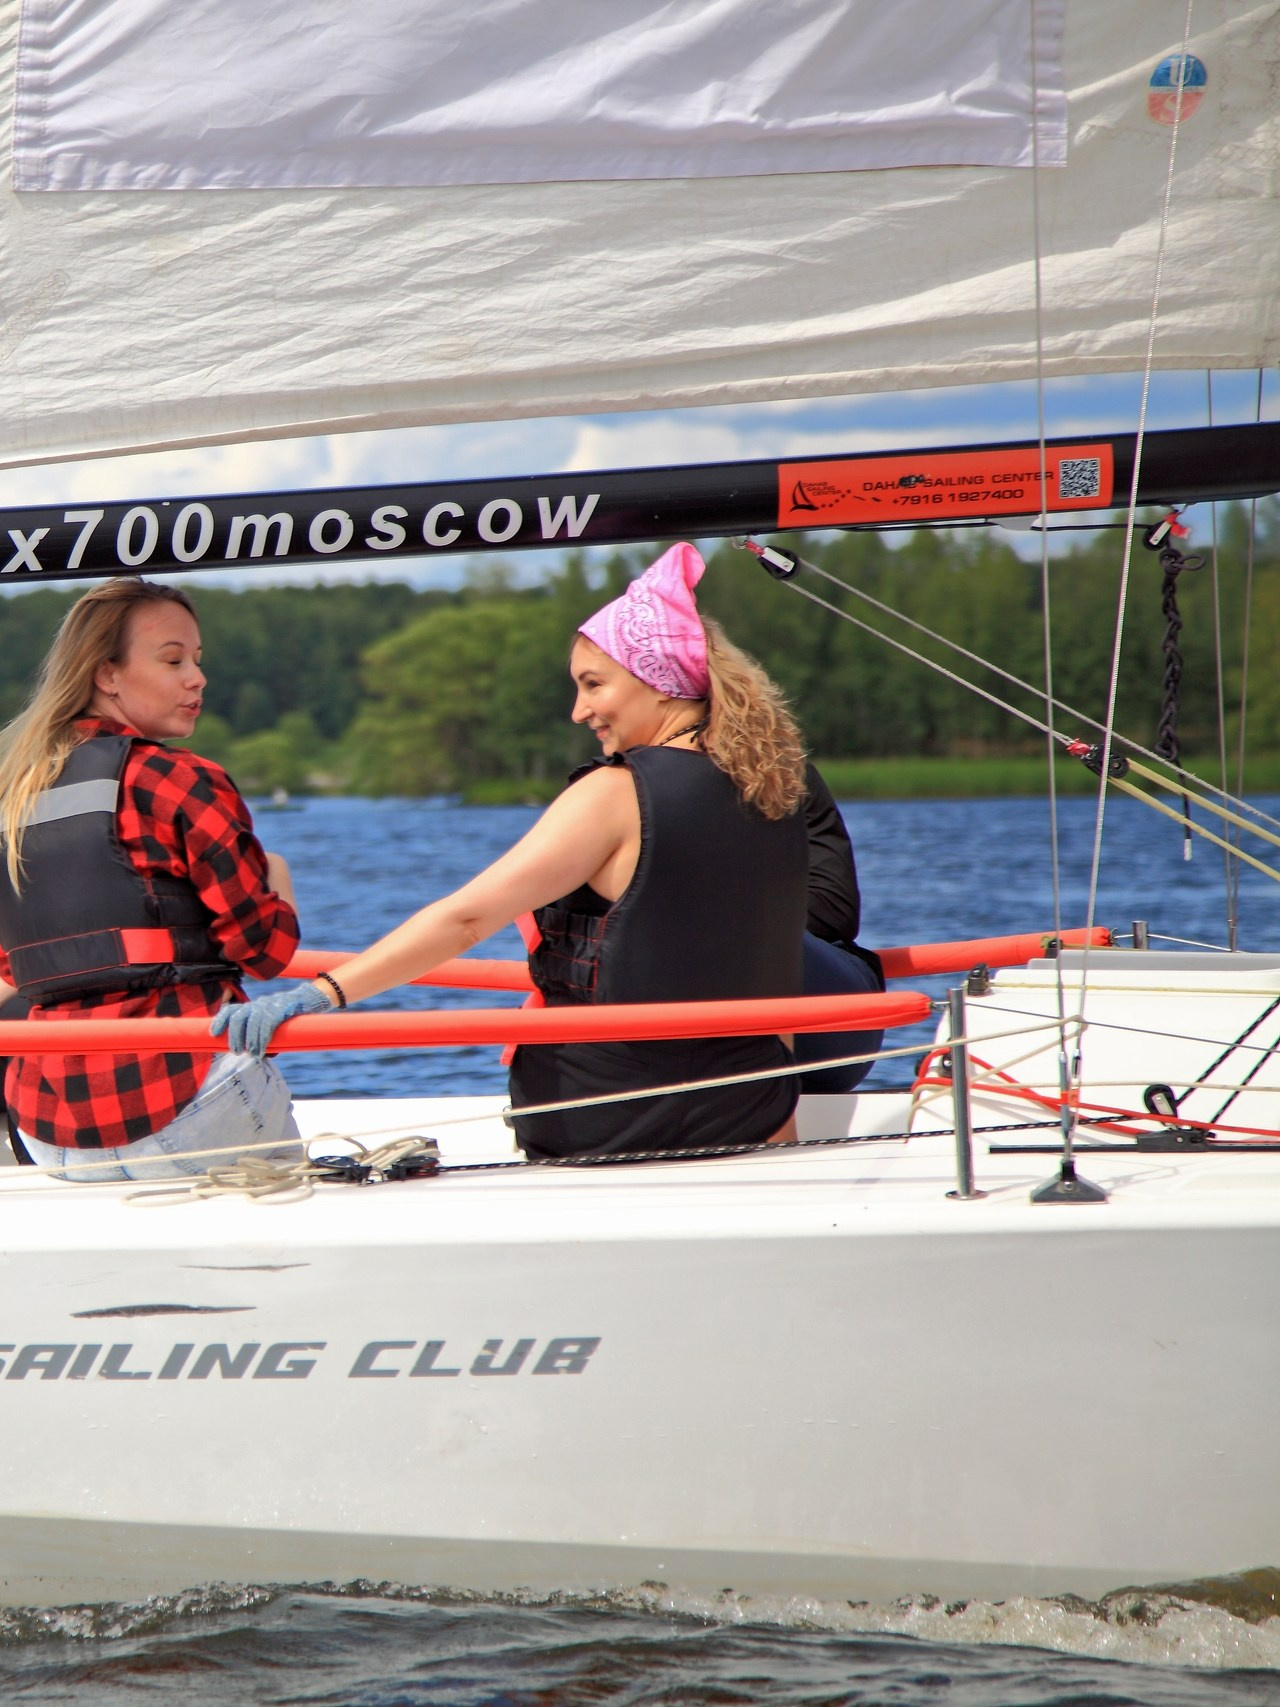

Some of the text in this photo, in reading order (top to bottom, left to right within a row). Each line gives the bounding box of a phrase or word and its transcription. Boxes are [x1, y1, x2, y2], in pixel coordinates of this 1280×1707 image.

[863, 471, 1055, 491] DAH SAILING CENTER
[892, 489, 1024, 506] +7916 1927400
[347, 1336, 603, 1379] CLUB
